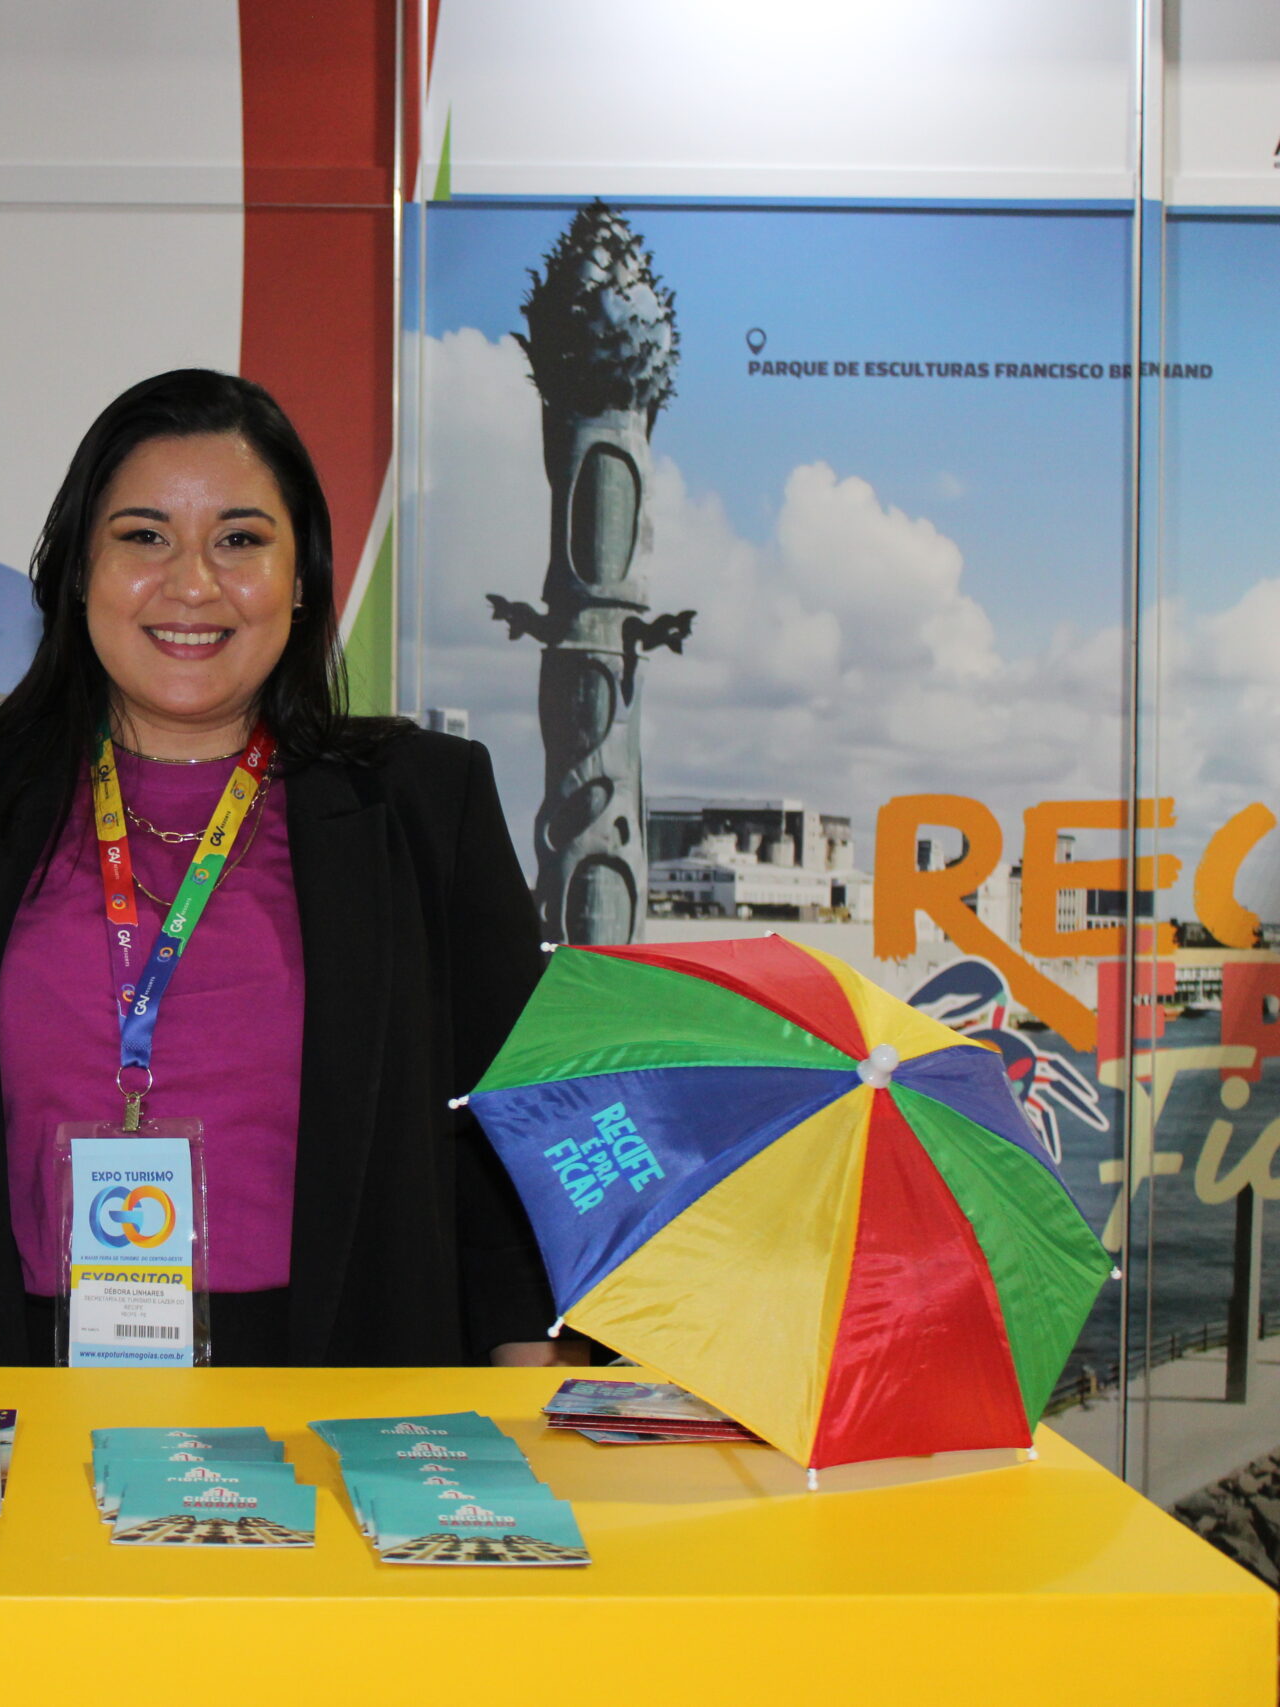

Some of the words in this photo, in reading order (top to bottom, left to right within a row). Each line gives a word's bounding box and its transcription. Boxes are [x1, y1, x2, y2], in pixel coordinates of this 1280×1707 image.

[748, 361, 829, 378] PARQUE
[833, 361, 860, 377] DE
[865, 361, 990, 378] ESCULTURAS
[994, 362, 1104, 379] FRANCISCO
[210, 826, 226, 846] GAV
[107, 846, 122, 864] GAV
[170, 913, 187, 932] GAV
[117, 929, 132, 948] GAV
[134, 994, 151, 1015] GAV
[580, 1136, 606, 1155] É
[591, 1101, 666, 1193] RECIFE
[91, 1171, 122, 1182] EXPO
[125, 1171, 174, 1182] TURISMO
[543, 1137, 605, 1215] FICAR
[587, 1150, 620, 1188] PRA
[132, 1289, 164, 1297] LINHARES
[438, 1514, 516, 1522] CIRCUITO
